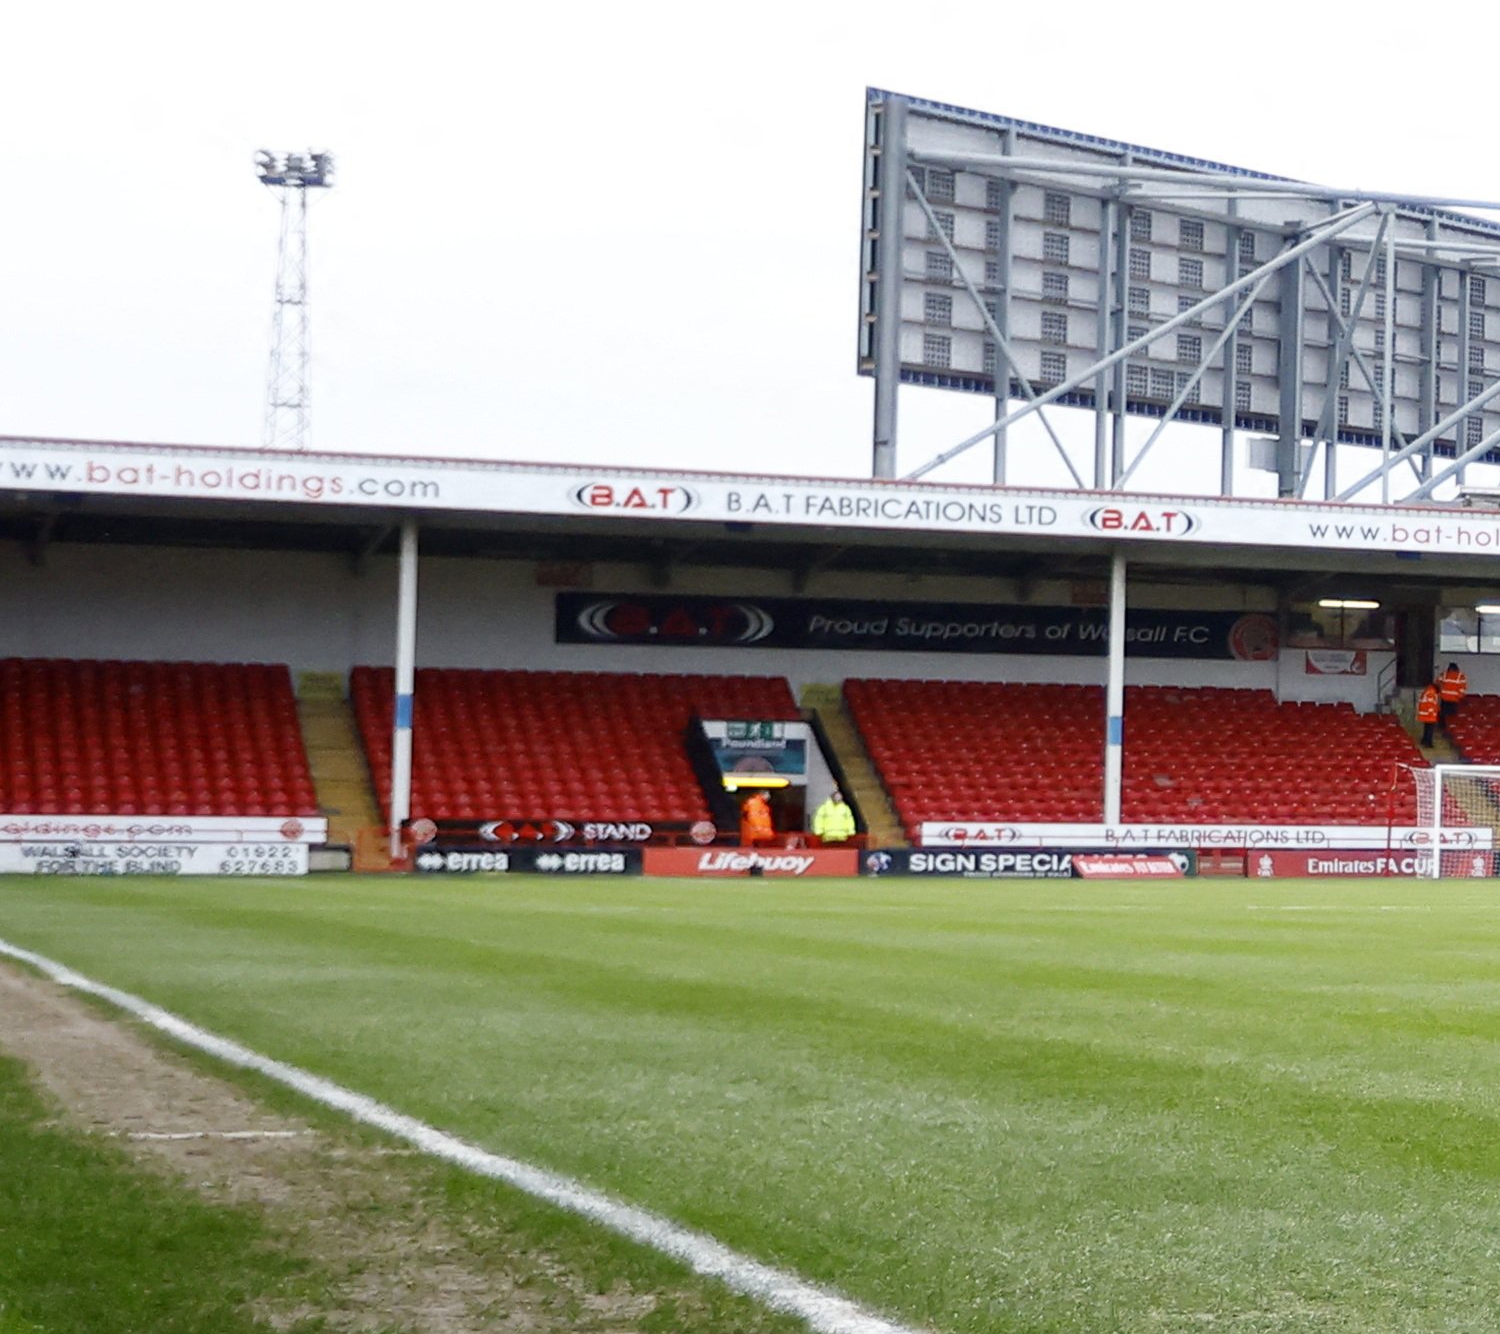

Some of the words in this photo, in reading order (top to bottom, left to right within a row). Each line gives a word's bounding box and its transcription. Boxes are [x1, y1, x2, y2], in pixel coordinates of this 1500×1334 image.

[0, 461, 440, 499] ww.bat-holdings.com
[591, 484, 678, 510] B.A.T
[727, 491, 796, 515] B.A.T
[805, 495, 1002, 524] FABRICATIONS
[1014, 504, 1057, 526] LTD
[1102, 509, 1179, 533] B.A.T
[810, 616, 889, 637] Proud
[894, 616, 1036, 640] Supporters
[1045, 620, 1072, 640] of
[1078, 622, 1167, 643] Wsall
[584, 823, 653, 841] STAND
[1156, 830, 1289, 845] FABRICATIONS
[1296, 832, 1326, 844] LTD
[116, 845, 198, 858] SOCIETY
[697, 851, 816, 875] Lifebuoy
[909, 853, 976, 872] SIGN
[1307, 858, 1375, 874] Emirates
[1376, 858, 1399, 874] FA
